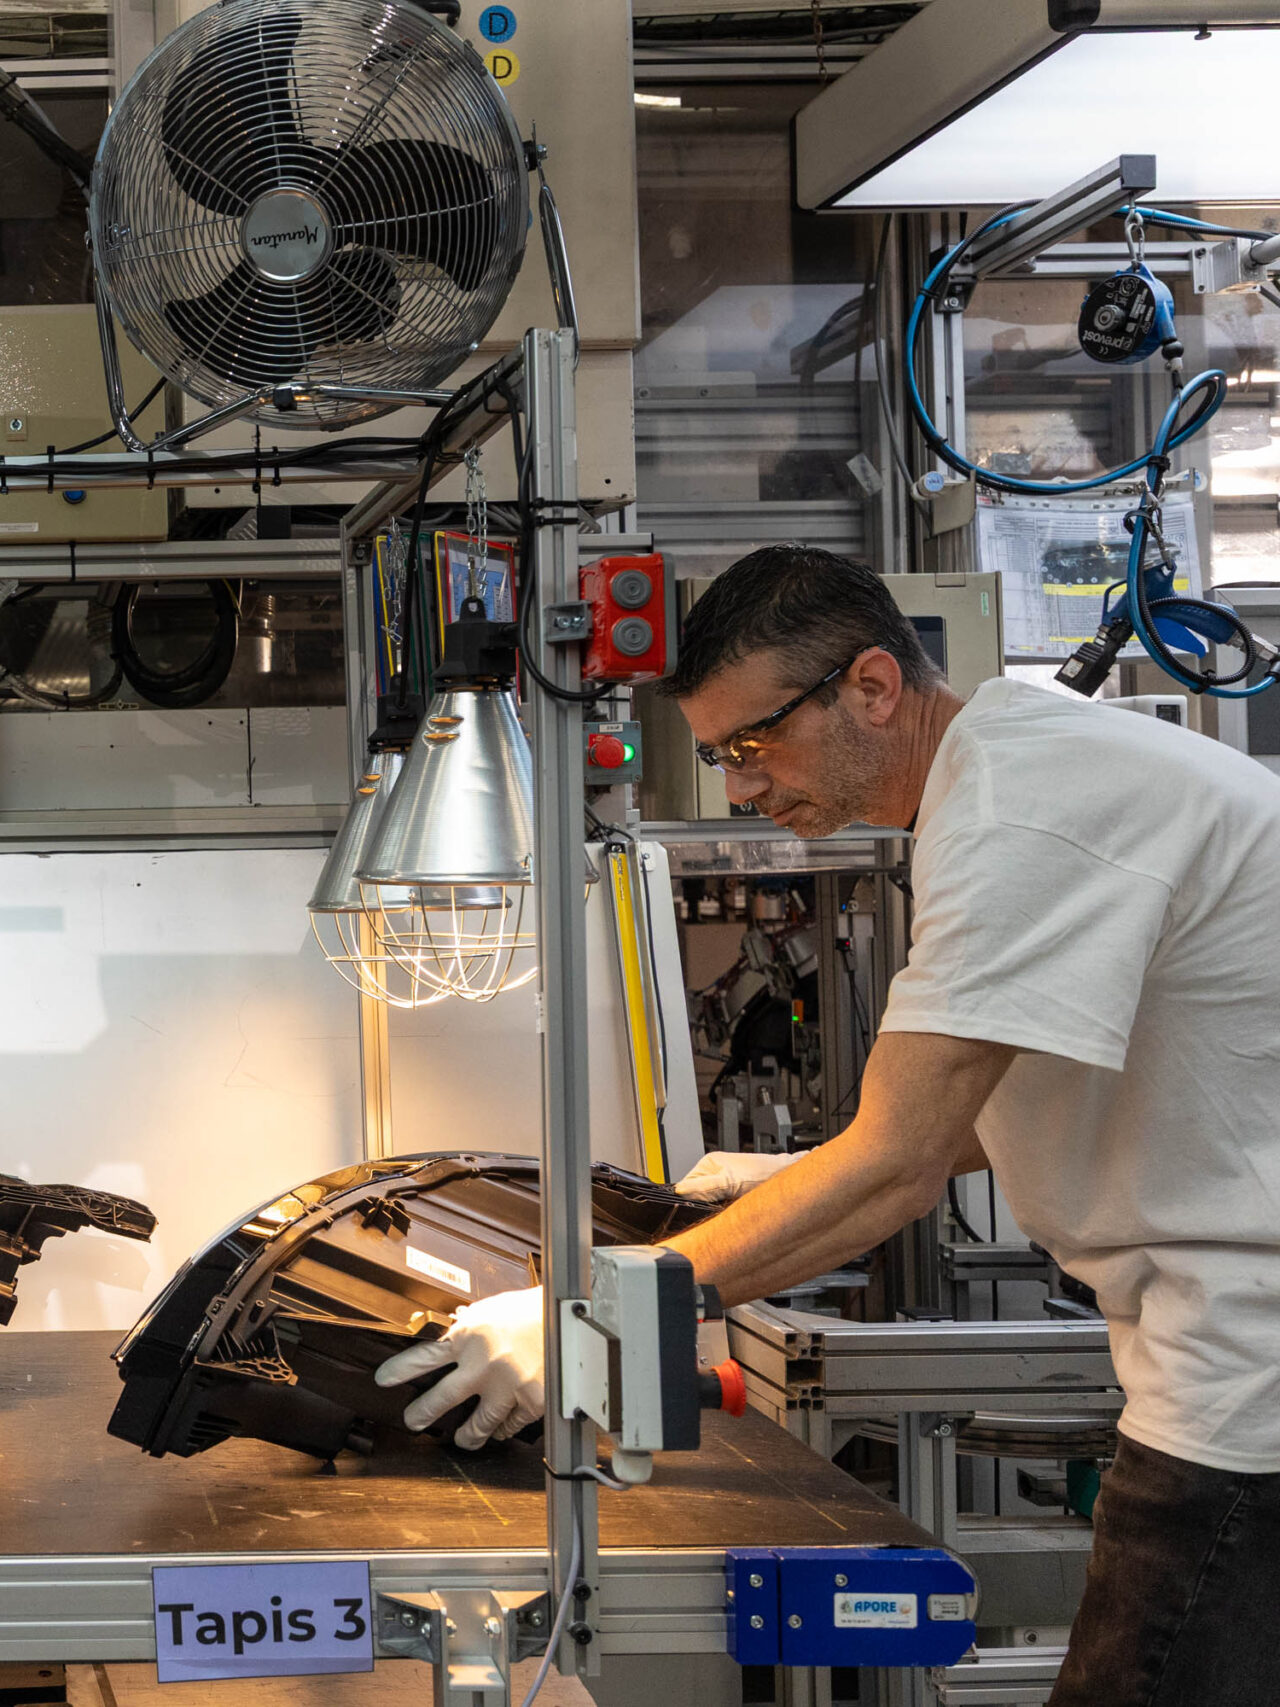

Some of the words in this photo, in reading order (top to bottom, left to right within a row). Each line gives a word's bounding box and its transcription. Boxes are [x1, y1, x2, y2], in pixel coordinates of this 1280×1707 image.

[489, 12, 508, 36] D
[493, 55, 513, 79] D
[251, 224, 319, 249] Manutan
[1082, 329, 1125, 349] prevost
[854, 1601, 897, 1613] APORE
[158, 1595, 316, 1655] Tapis
[333, 1598, 366, 1641] 3
